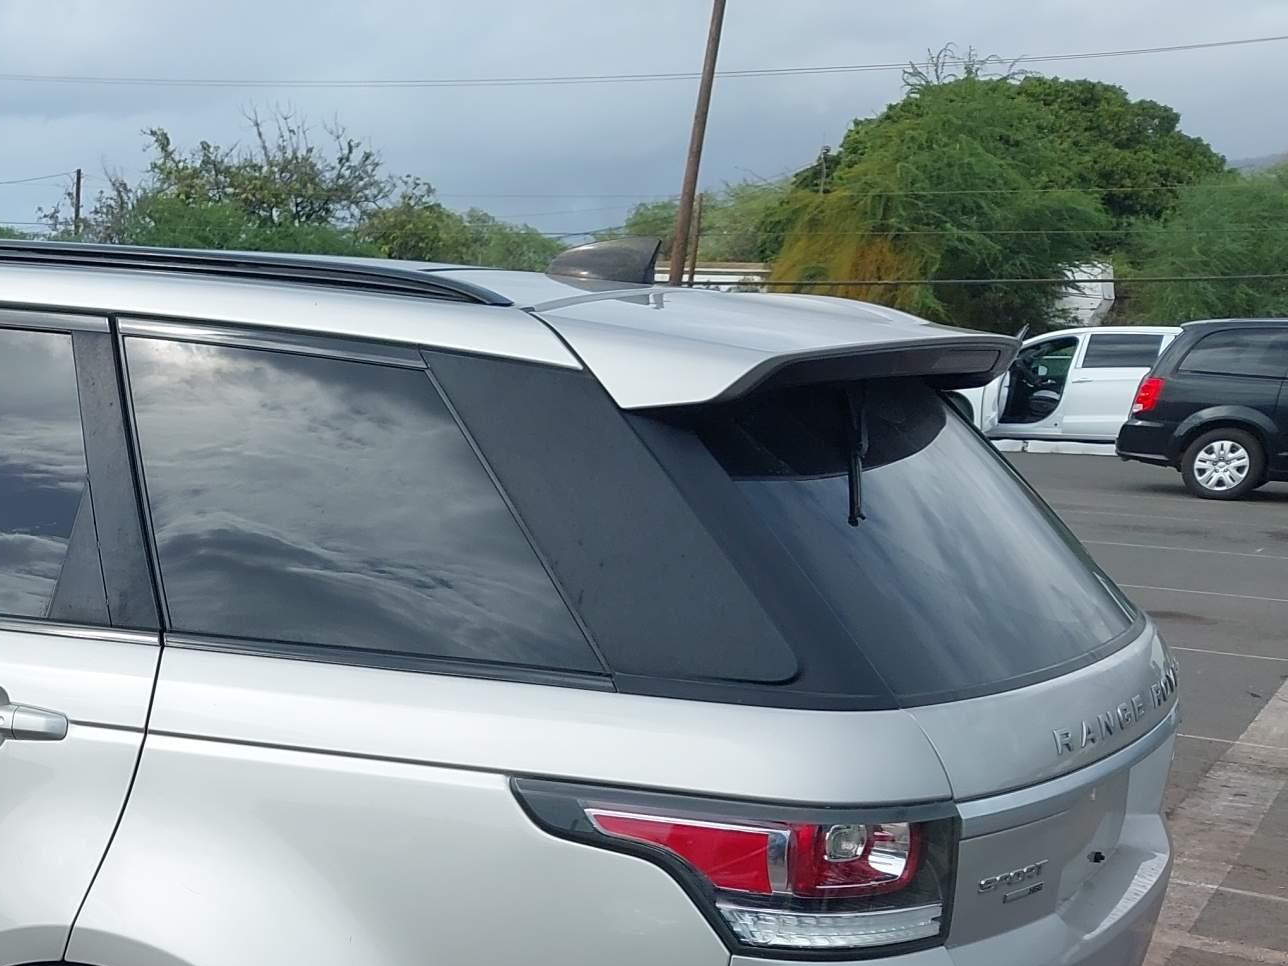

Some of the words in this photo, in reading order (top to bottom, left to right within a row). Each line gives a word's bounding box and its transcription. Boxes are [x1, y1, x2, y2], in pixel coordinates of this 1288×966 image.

[1052, 693, 1146, 755] RANGE
[1150, 659, 1179, 709] ROV
[977, 859, 1049, 894] SPORT
